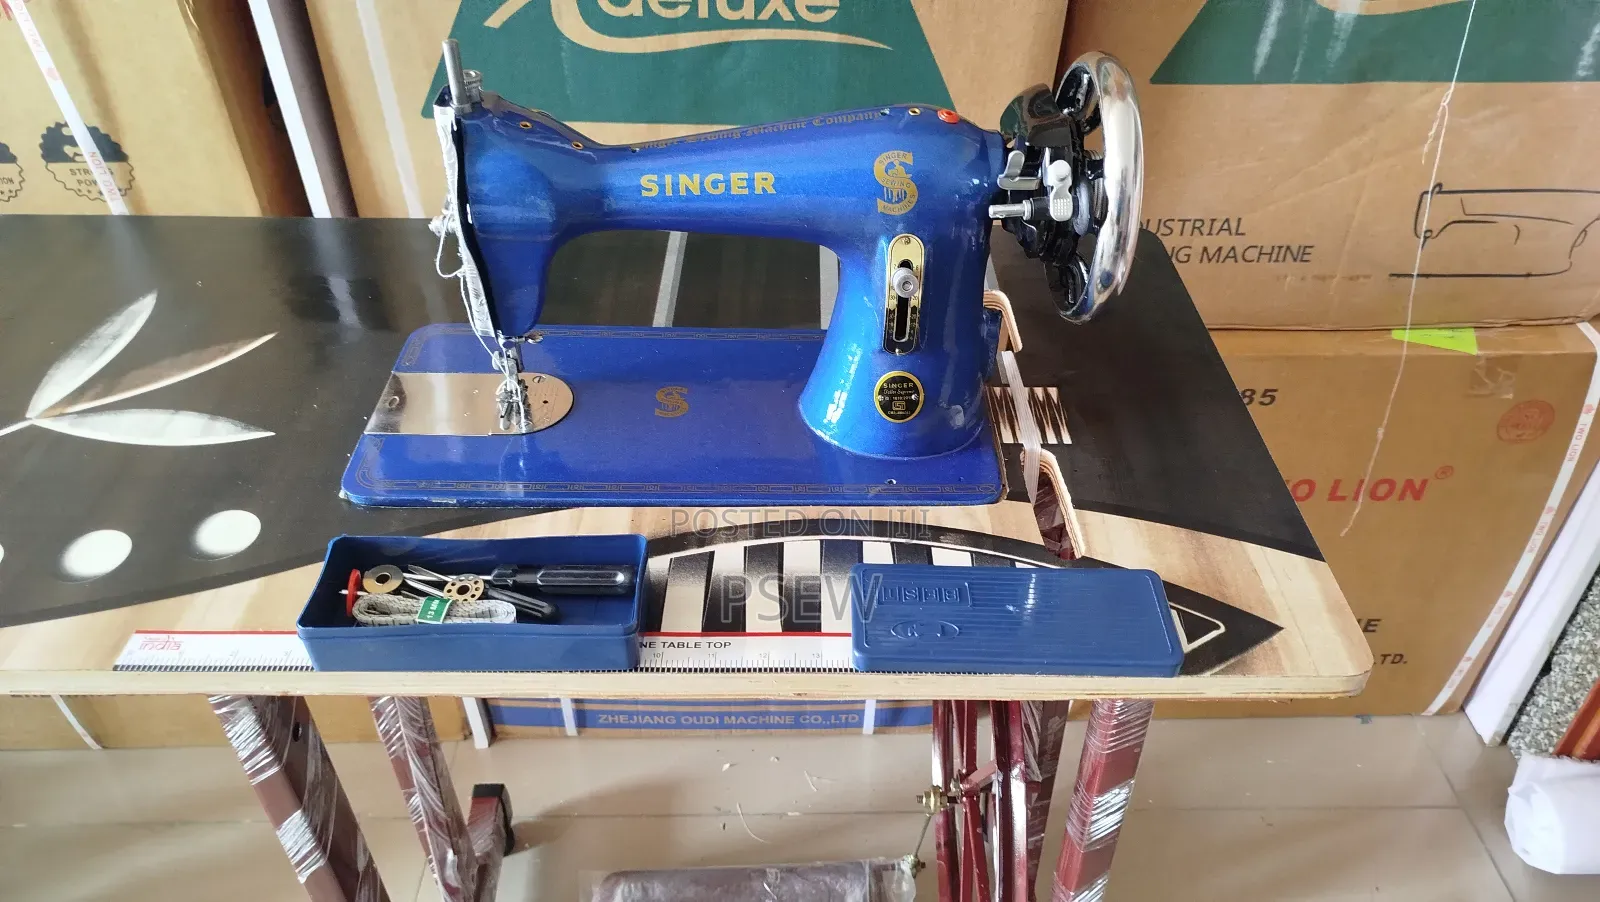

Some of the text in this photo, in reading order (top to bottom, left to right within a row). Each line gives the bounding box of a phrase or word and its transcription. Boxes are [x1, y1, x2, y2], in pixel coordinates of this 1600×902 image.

[878, 152, 908, 166] SINGER
[639, 171, 776, 197] SINGER
[1140, 217, 1247, 237] USTRIAL
[1199, 245, 1315, 264] MACHINE
[1327, 478, 1429, 502] LION
[660, 641, 702, 649] TABLE
[706, 641, 732, 649] TOP
[598, 713, 677, 725] ZHEJIANG
[680, 713, 720, 725] OUDI
[724, 714, 795, 725] MACHINE
